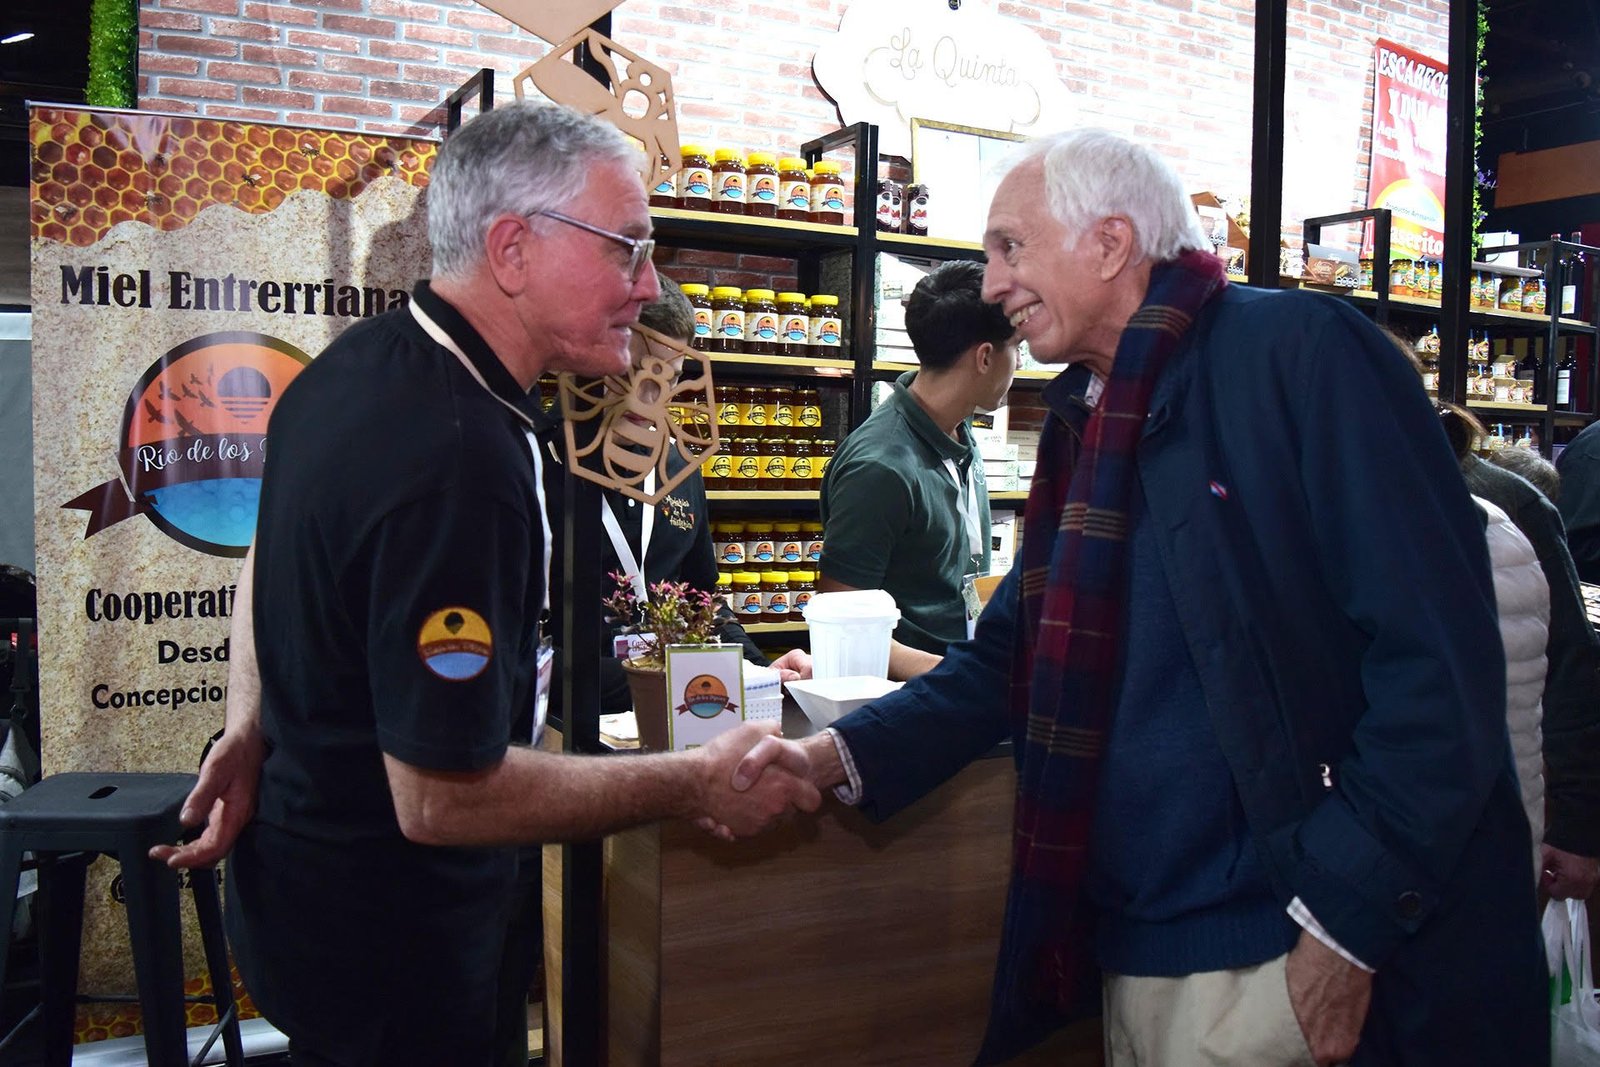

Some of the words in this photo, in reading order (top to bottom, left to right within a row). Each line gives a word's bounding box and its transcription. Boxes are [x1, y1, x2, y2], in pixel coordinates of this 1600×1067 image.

[890, 26, 924, 80] La
[933, 35, 1019, 88] Quinta
[60, 264, 152, 309] Miel
[167, 270, 410, 318] Entrerriana
[137, 445, 183, 472] Río
[187, 438, 214, 463] de
[218, 437, 254, 462] los
[157, 637, 230, 664] Desd
[91, 679, 228, 710] Concepcio
